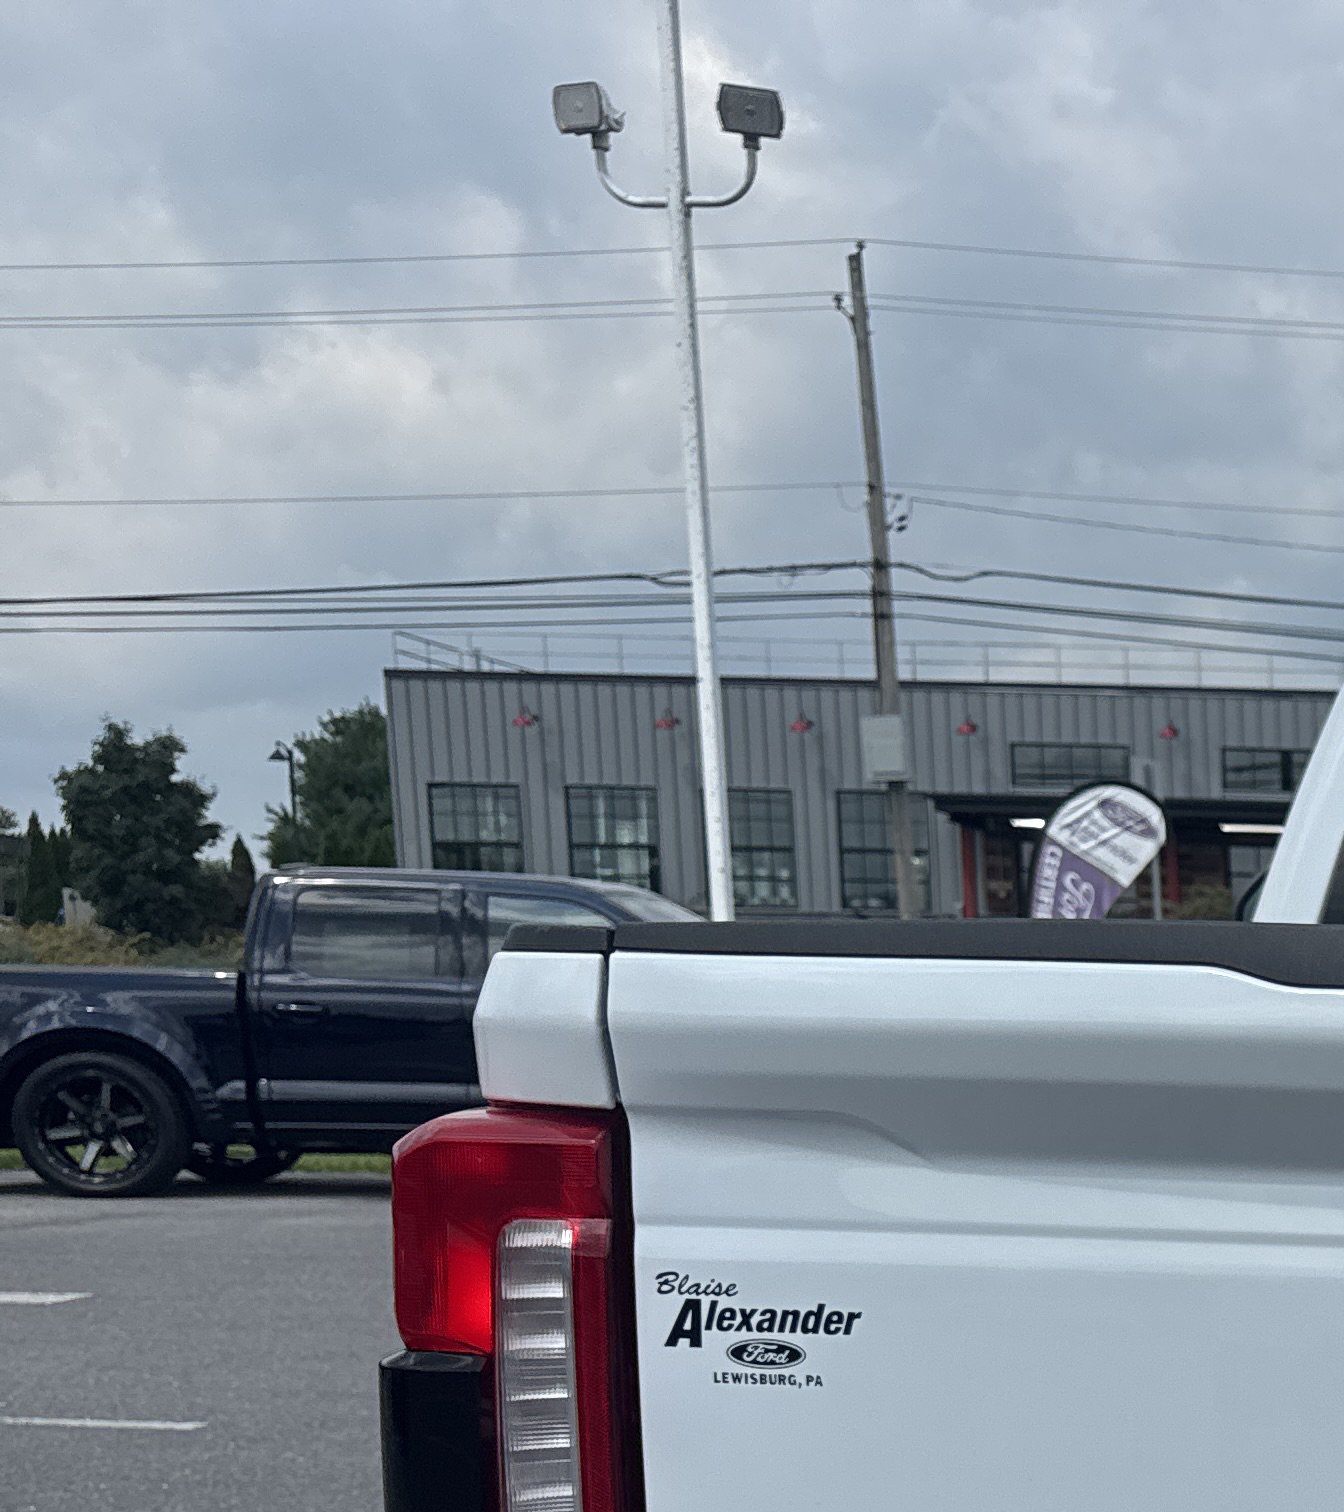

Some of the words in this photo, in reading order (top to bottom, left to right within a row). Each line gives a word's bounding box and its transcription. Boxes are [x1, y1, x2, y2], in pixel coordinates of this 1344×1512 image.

[655, 1271, 738, 1297] Blaise
[664, 1298, 862, 1348] Alexander
[742, 1343, 790, 1364] Ford
[713, 1371, 802, 1389] LEWISBURG,
[806, 1374, 823, 1387] PA
